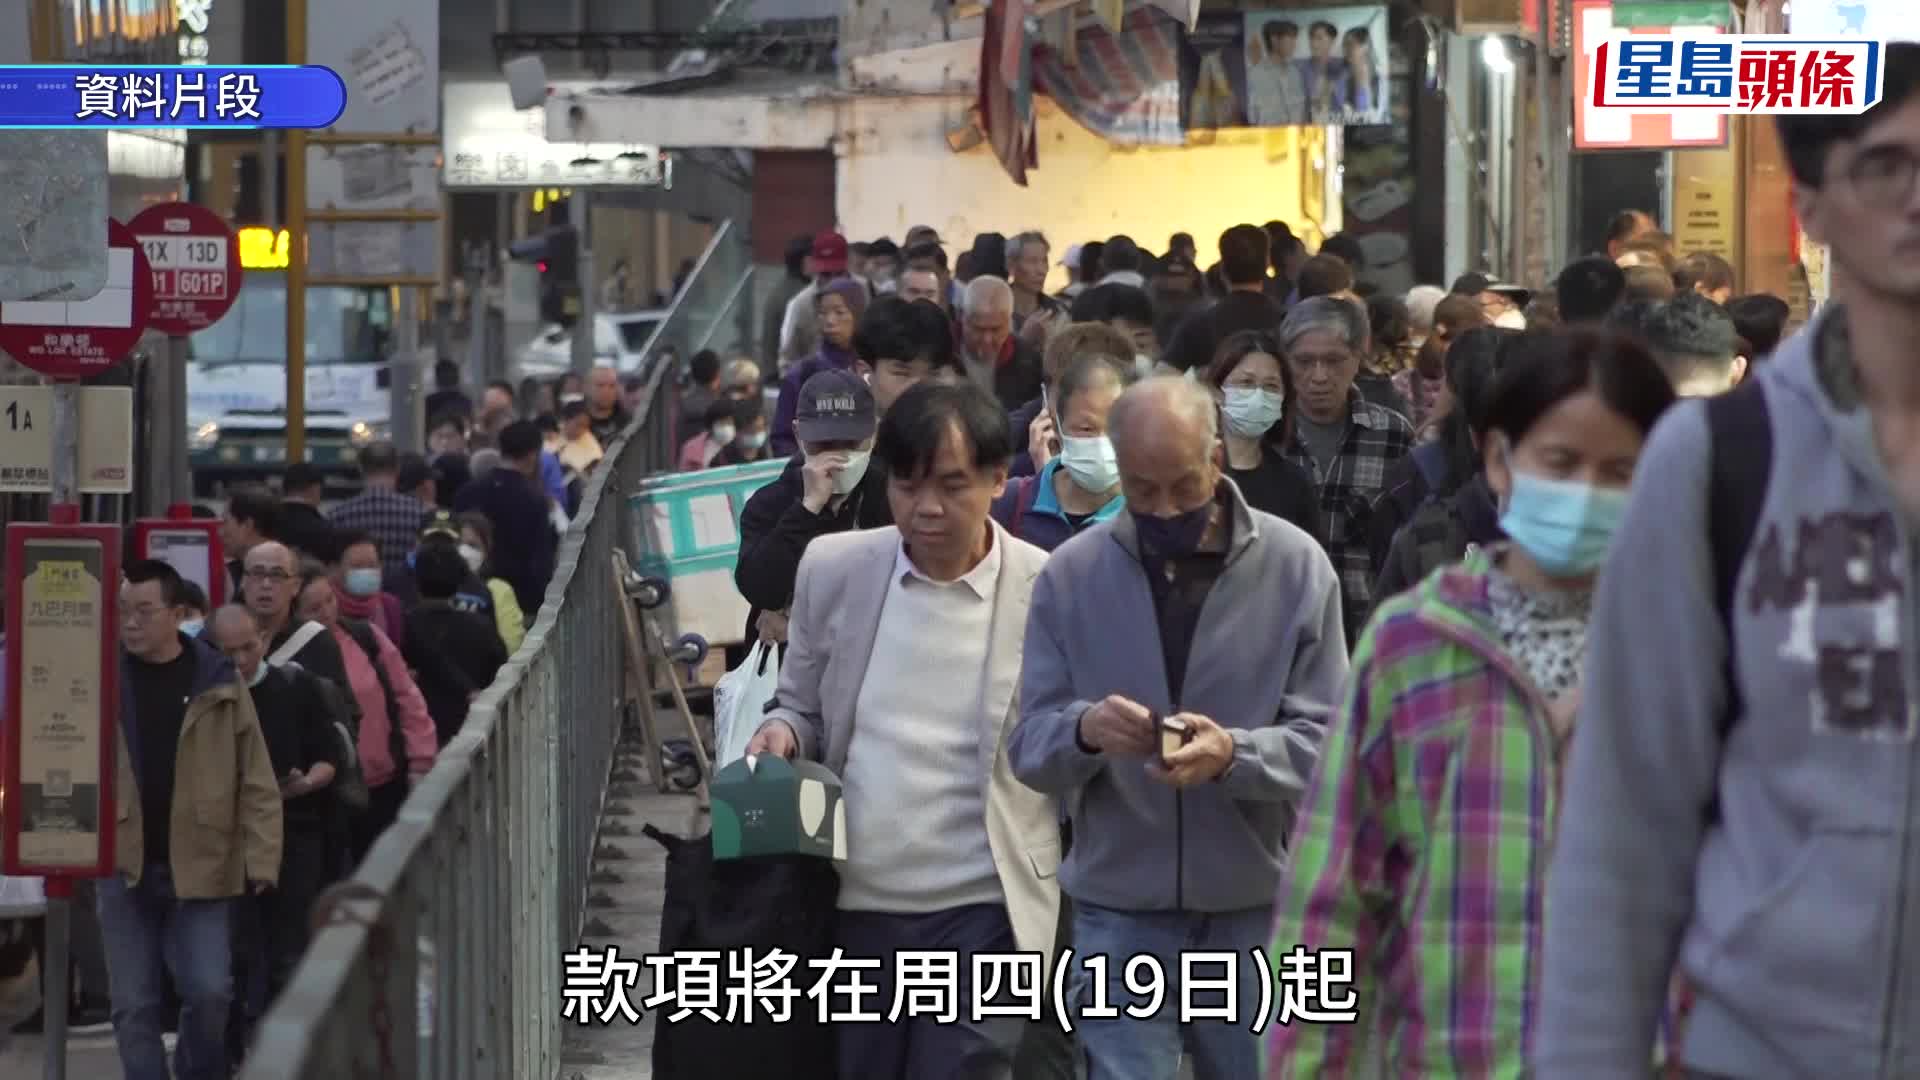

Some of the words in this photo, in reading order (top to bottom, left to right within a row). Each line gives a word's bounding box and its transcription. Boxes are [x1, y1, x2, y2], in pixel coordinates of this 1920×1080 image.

[142, 240, 168, 262] 1X
[186, 241, 218, 262] 13D
[181, 272, 223, 294] 601P
[6, 400, 33, 431] 1A
